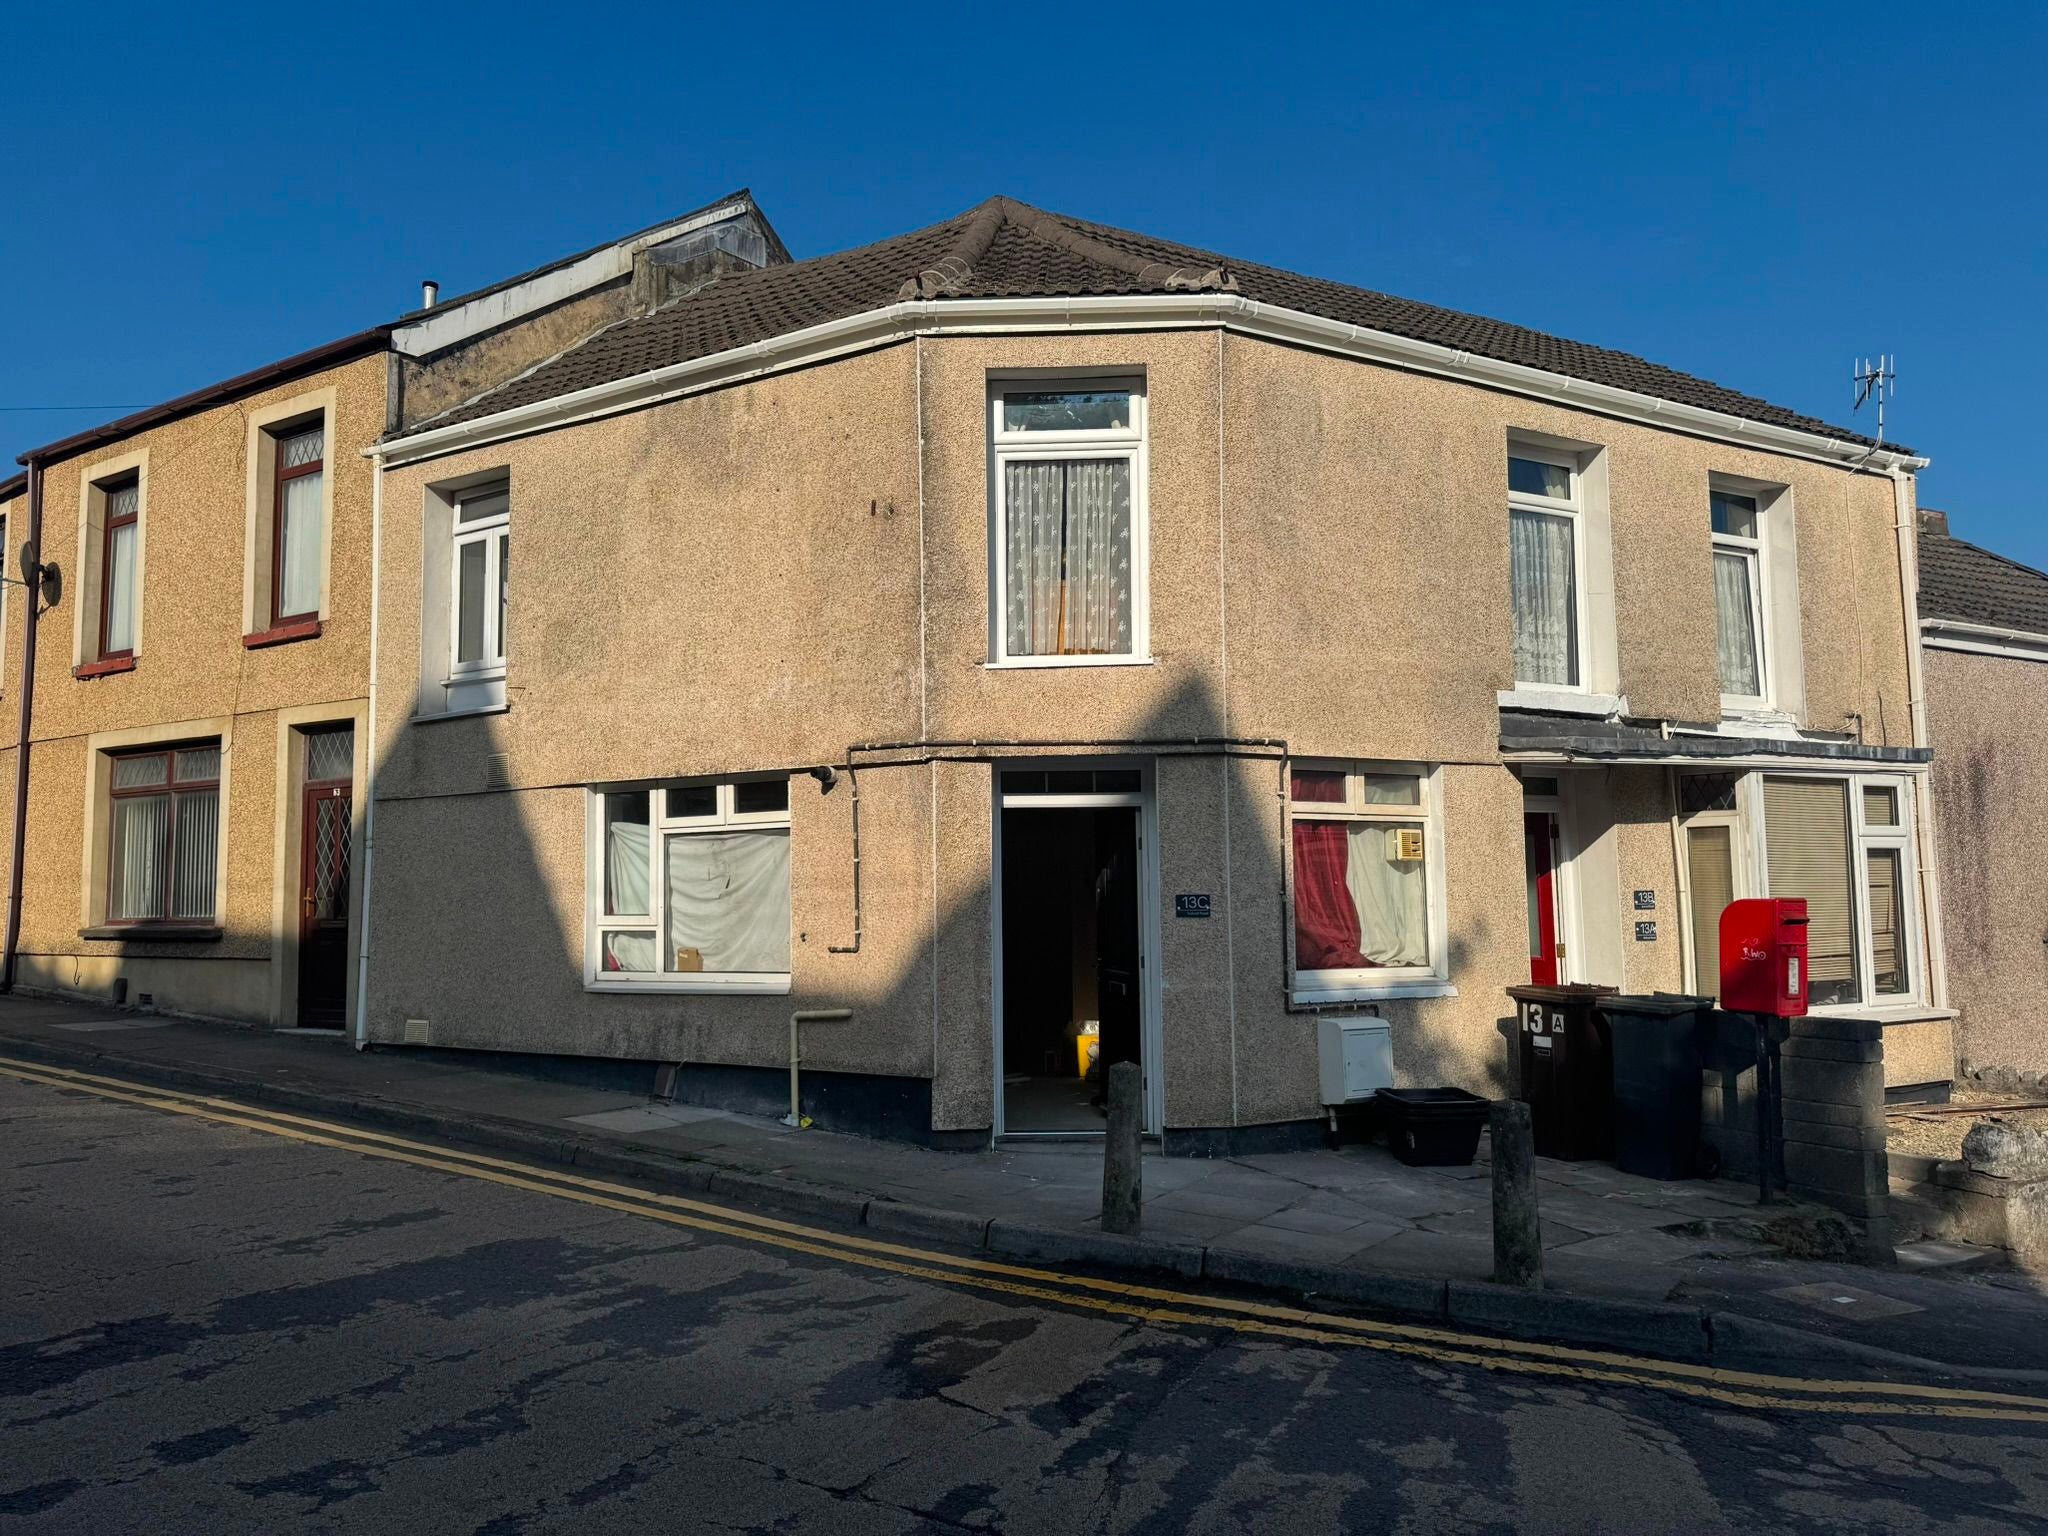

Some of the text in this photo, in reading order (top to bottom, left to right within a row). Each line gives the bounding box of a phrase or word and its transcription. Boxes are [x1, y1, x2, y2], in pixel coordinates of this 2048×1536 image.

[1182, 896, 1208, 909] 13C
[1638, 892, 1654, 903] 13B
[1640, 923, 1656, 934] 13A
[1522, 1002, 1563, 1034] 13 A
